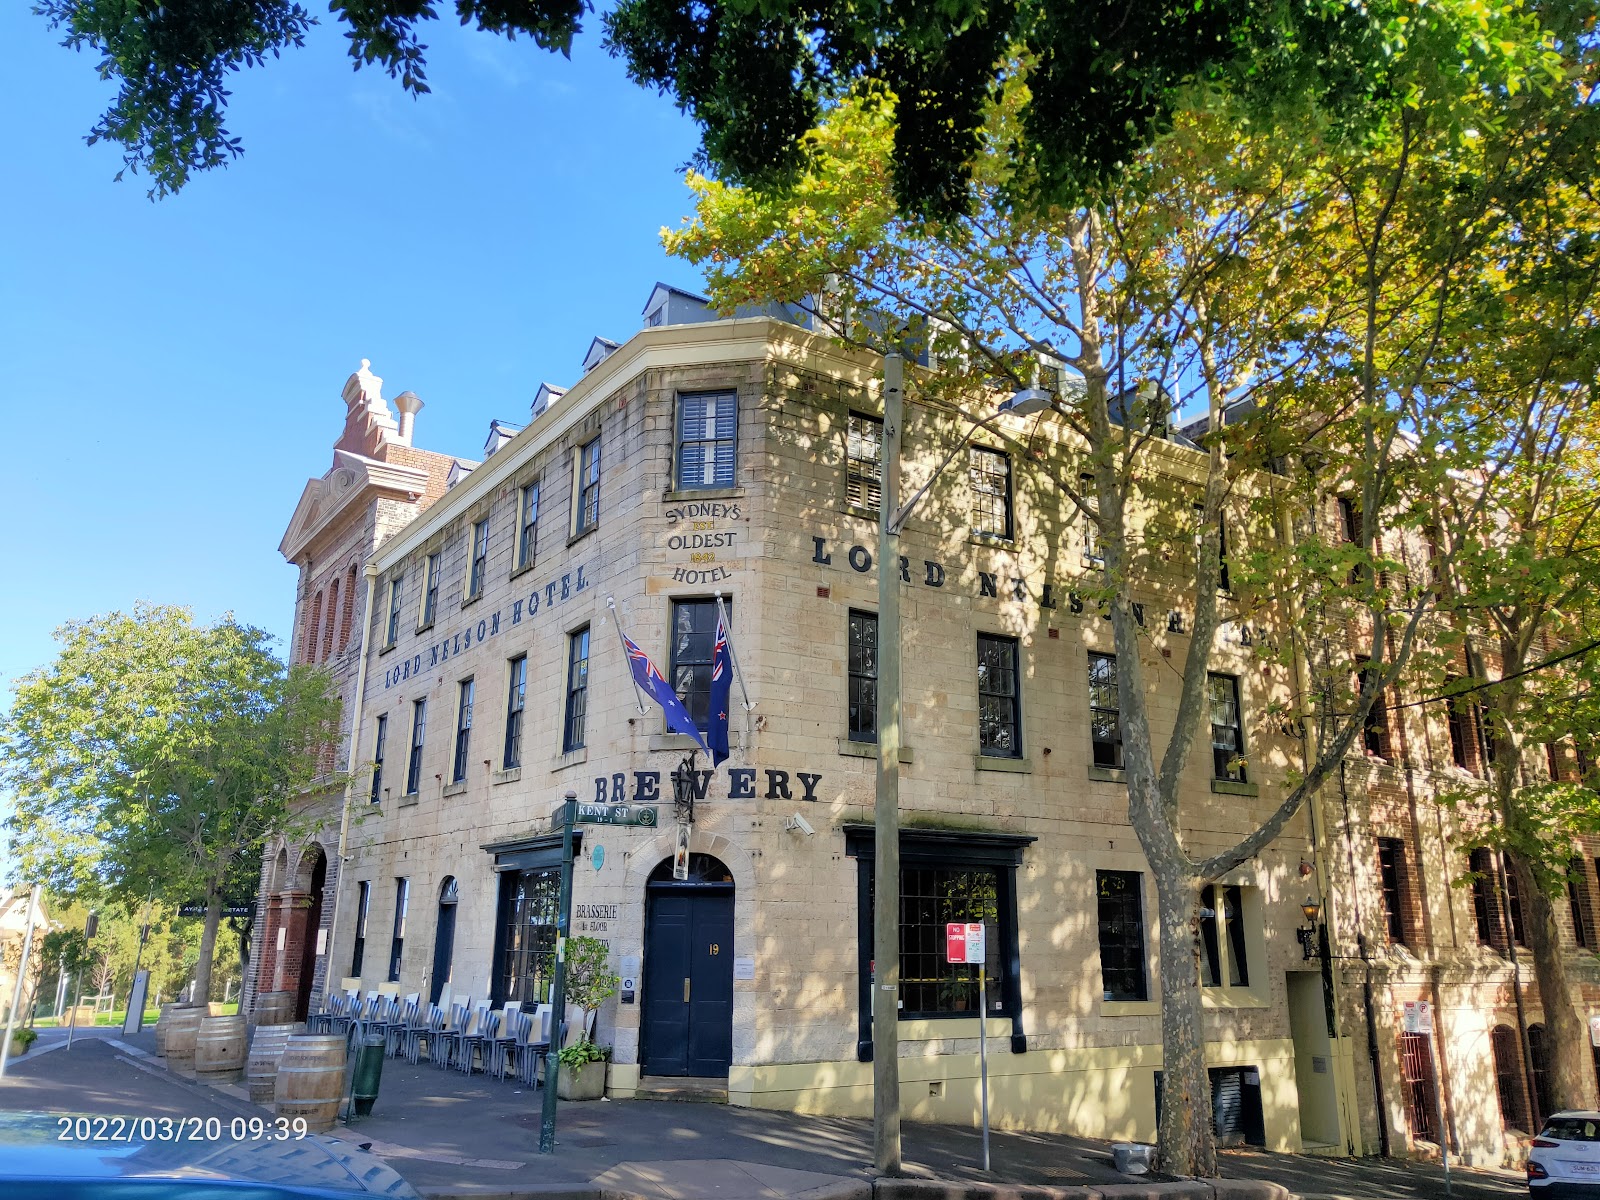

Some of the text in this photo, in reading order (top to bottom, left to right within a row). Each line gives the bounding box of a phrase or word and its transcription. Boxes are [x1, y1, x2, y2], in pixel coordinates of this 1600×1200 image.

[665, 503, 742, 525] SYDNEY'S
[668, 532, 737, 550] OLDEST
[672, 566, 732, 585] HOTEL
[384, 654, 421, 690] LORD
[430, 610, 501, 667] NELSON
[595, 768, 823, 803] BREWERY
[578, 805, 629, 818] KENT ST
[576, 904, 618, 919] BRASSERIE
[590, 921, 608, 932] FLOOR
[709, 943, 720, 956] 19
